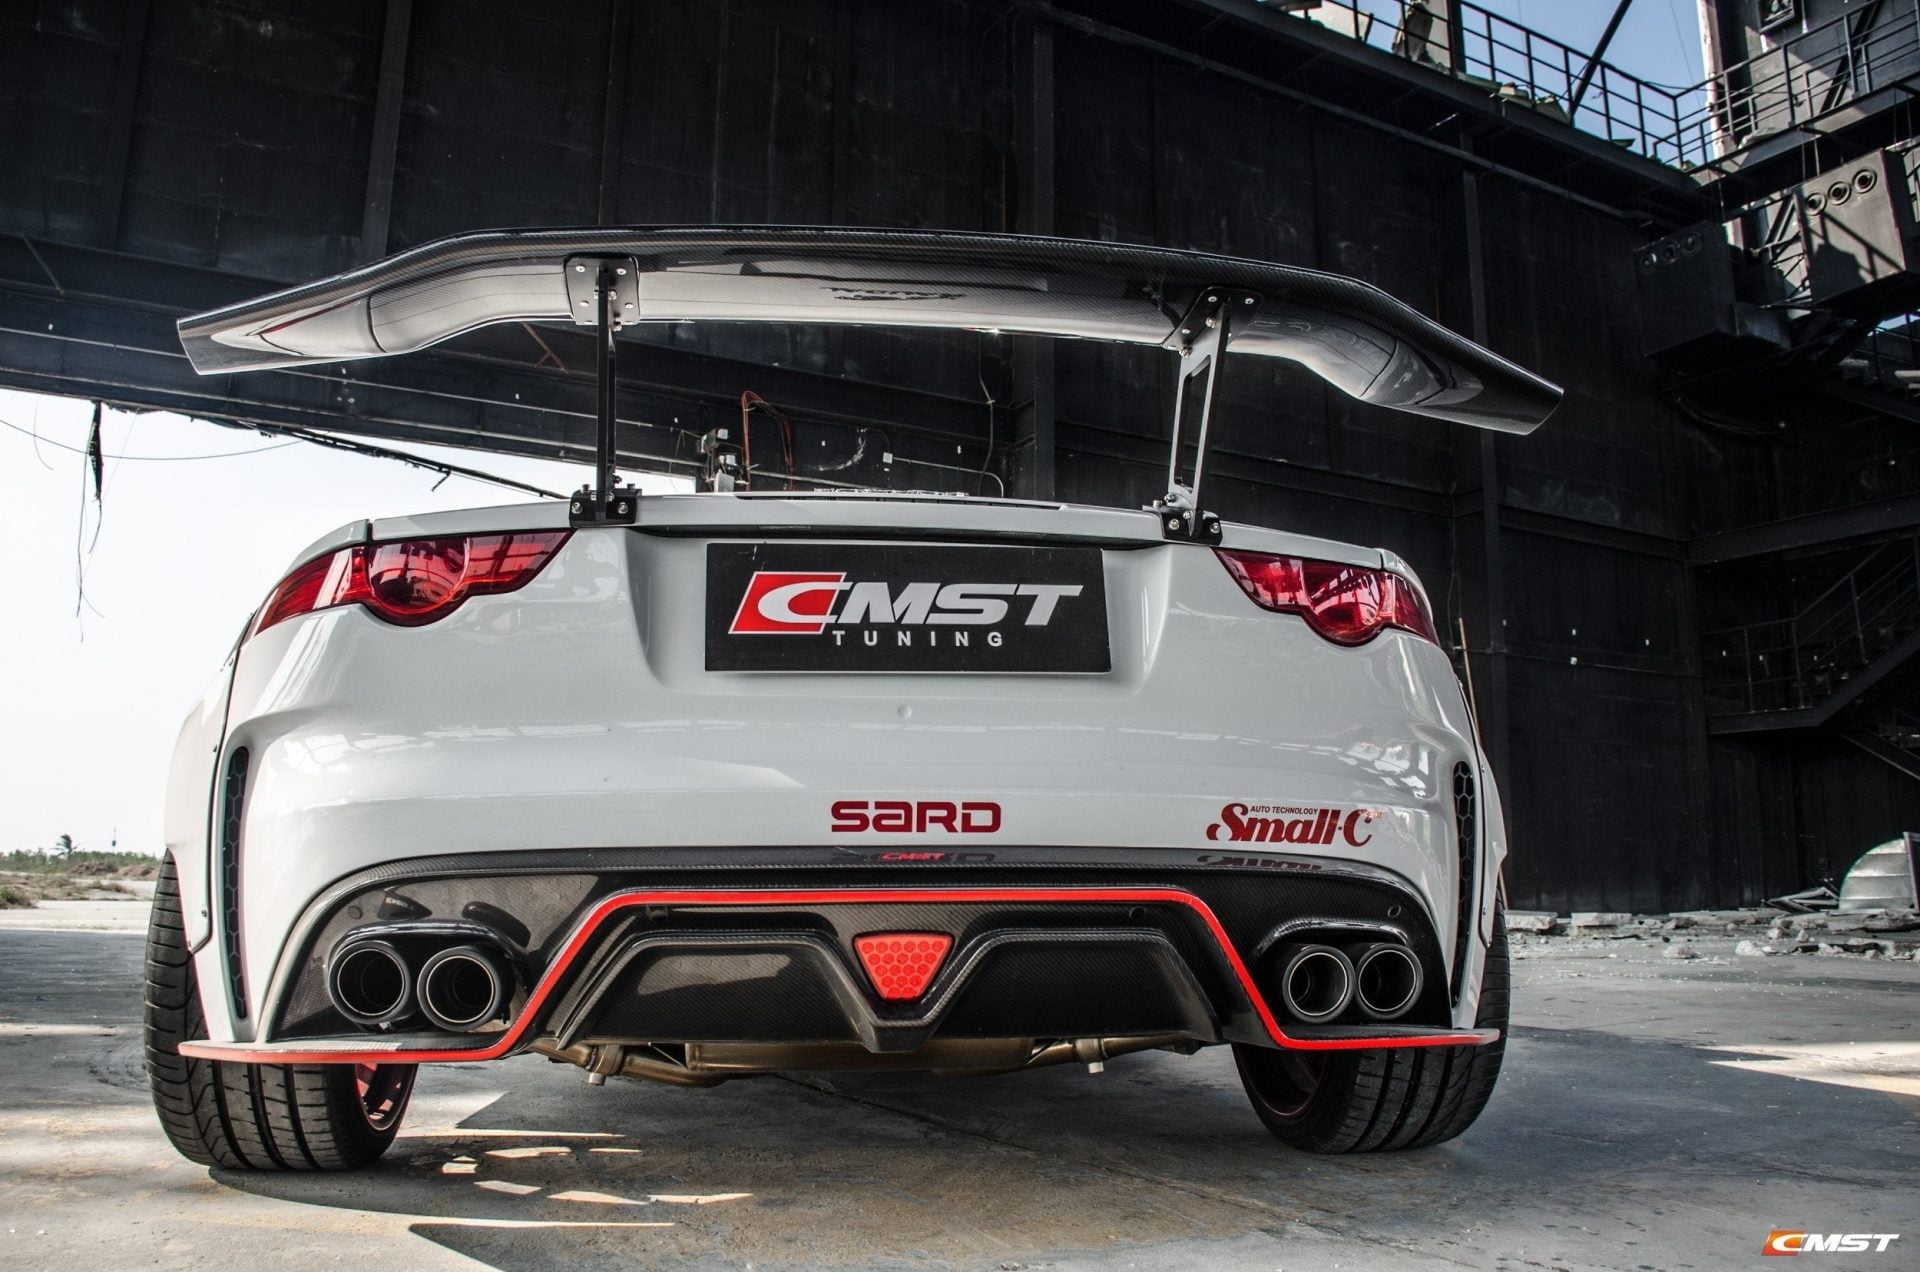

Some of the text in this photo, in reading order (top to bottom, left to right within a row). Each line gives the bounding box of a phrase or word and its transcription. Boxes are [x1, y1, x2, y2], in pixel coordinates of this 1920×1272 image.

[757, 581, 1084, 626] CMST
[832, 630, 1003, 647] TUNING
[1250, 805, 1318, 815] AUTO TECHNOLOGY
